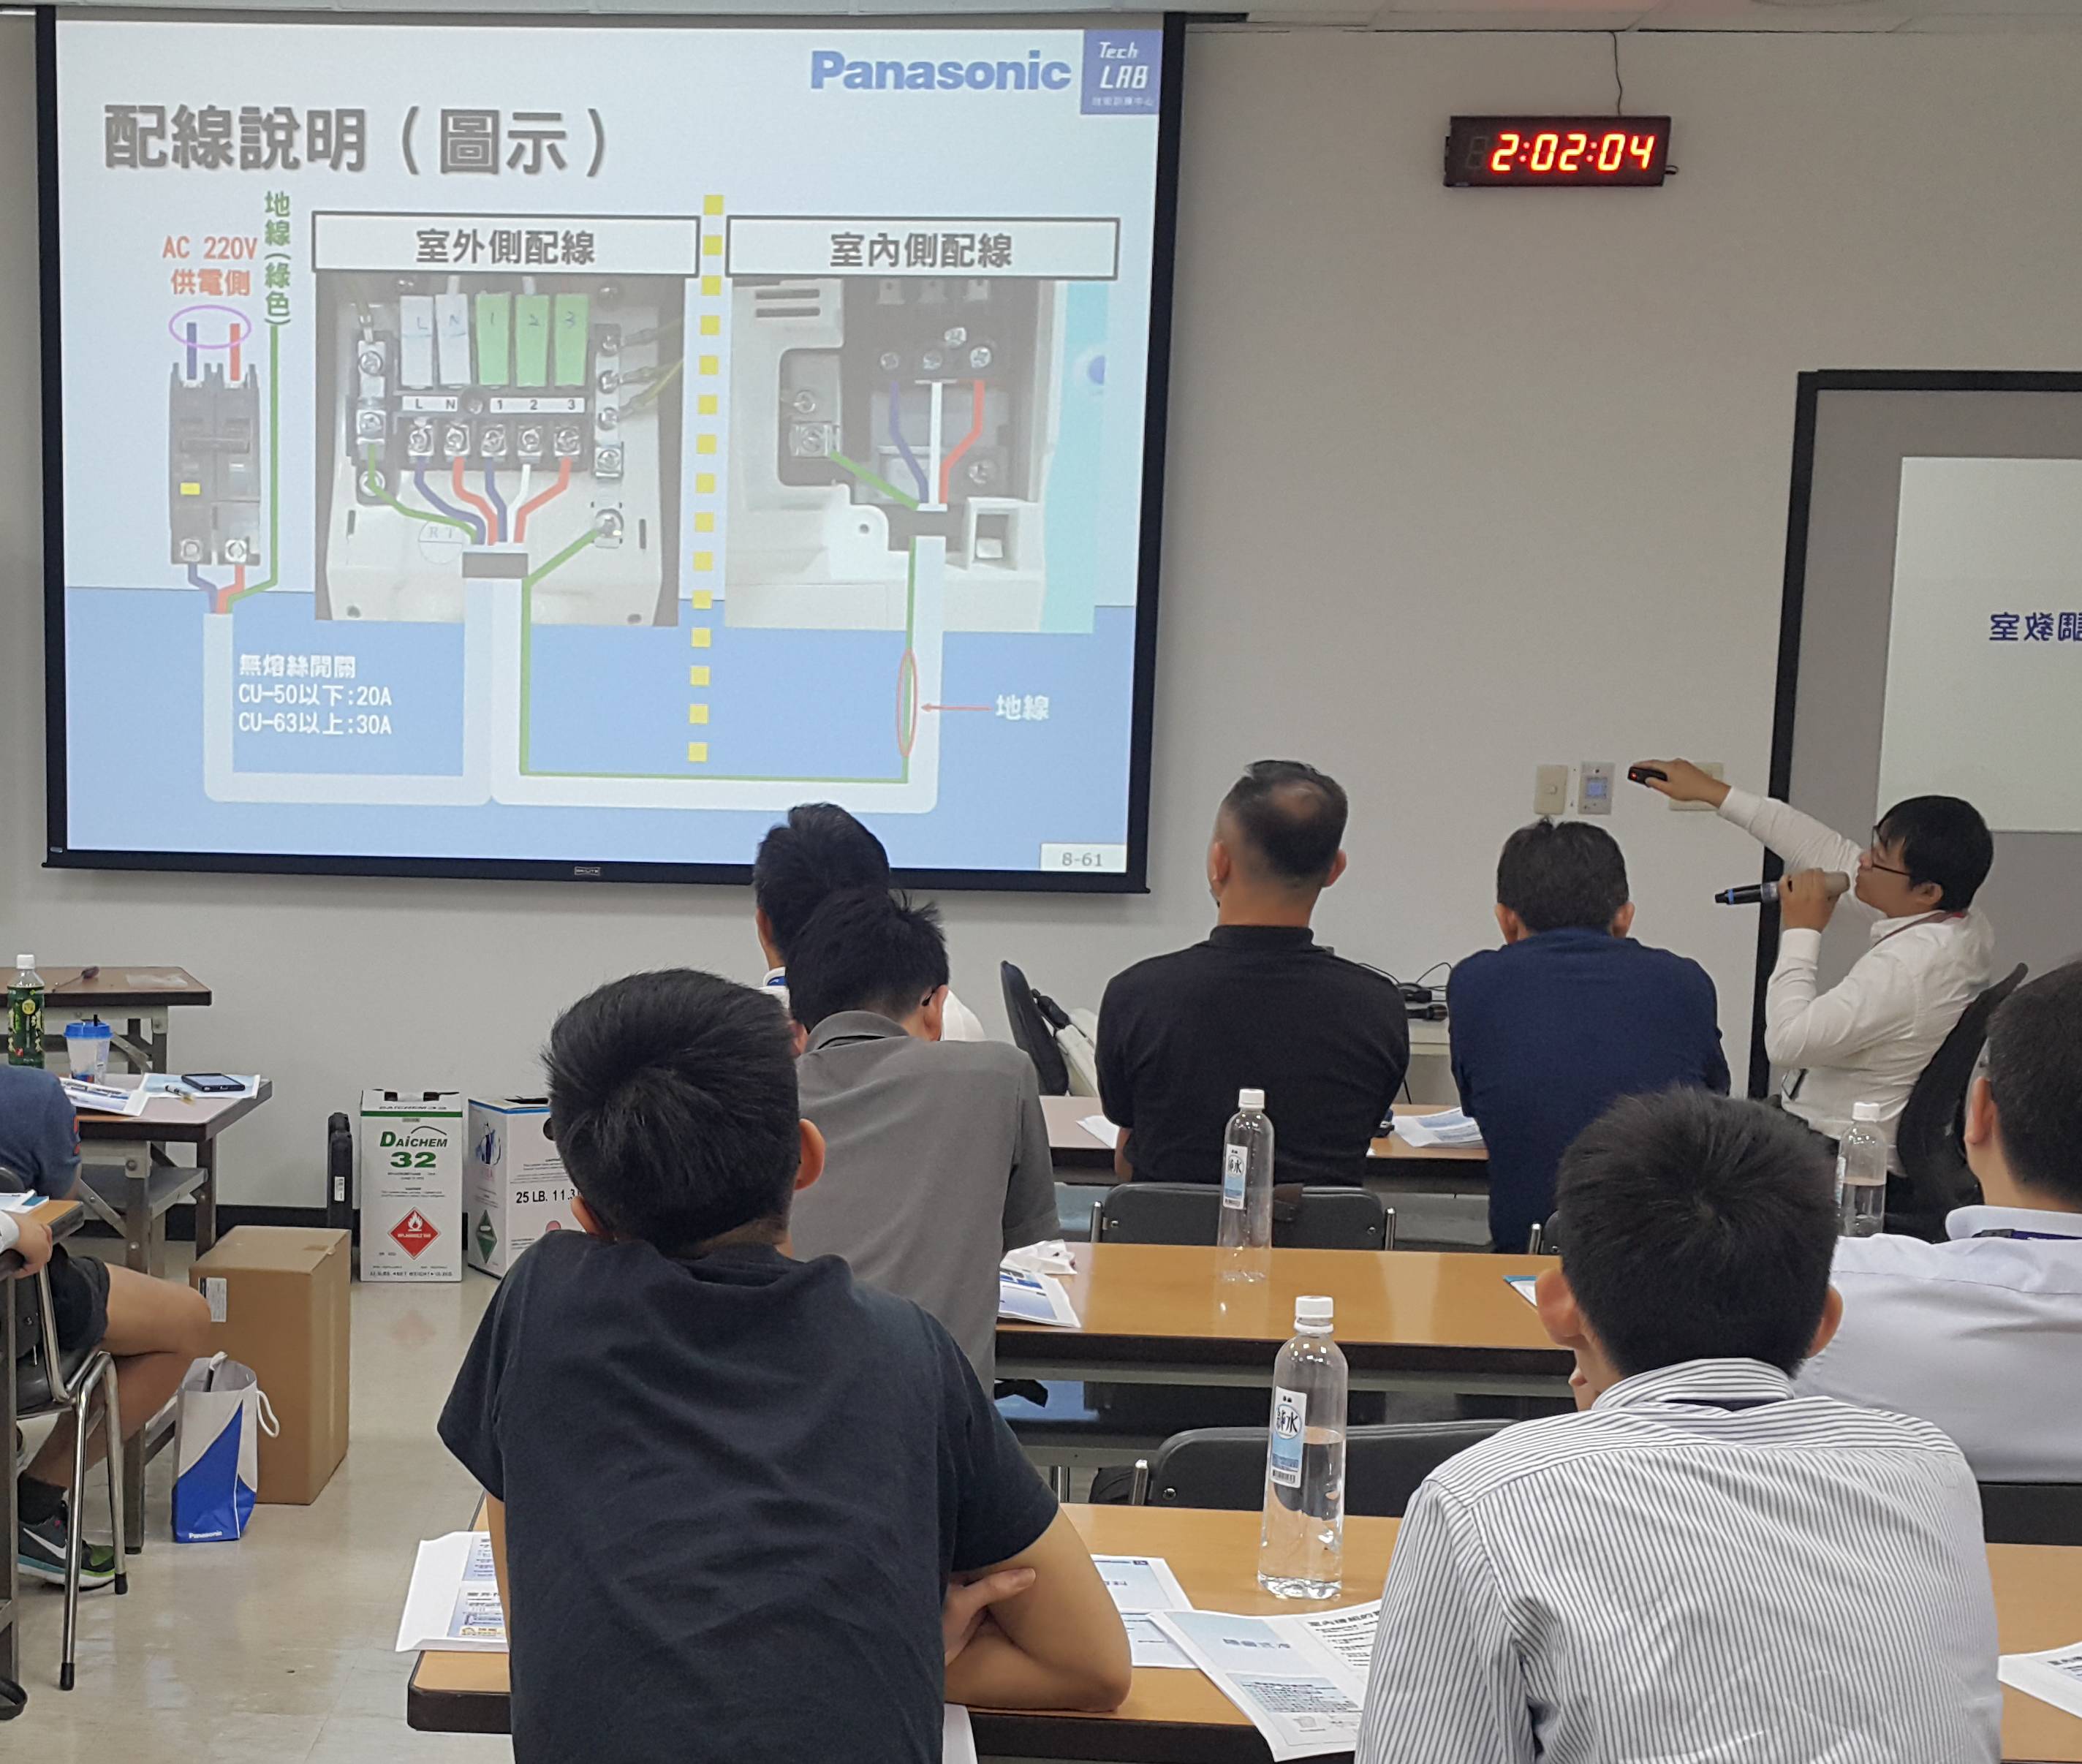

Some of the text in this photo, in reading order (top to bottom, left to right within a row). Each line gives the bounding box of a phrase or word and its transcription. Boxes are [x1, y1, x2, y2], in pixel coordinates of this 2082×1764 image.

[1099, 41, 1139, 58] Tech
[811, 50, 1072, 90] Panasonic
[1099, 65, 1149, 89] LAB
[1491, 133, 1656, 172] 2:02:04
[162, 235, 258, 260] AC 220V
[415, 228, 595, 265] 室外側配線
[829, 232, 1012, 268] 室內側配線
[170, 268, 251, 296] 供電側
[415, 398, 576, 411] L N 1 2 3
[995, 694, 1050, 722] 地線
[1061, 852, 1102, 867] 8-61
[390, 1151, 436, 1168] 32
[516, 1191, 529, 1204] 25
[532, 1189, 548, 1203] LB.
